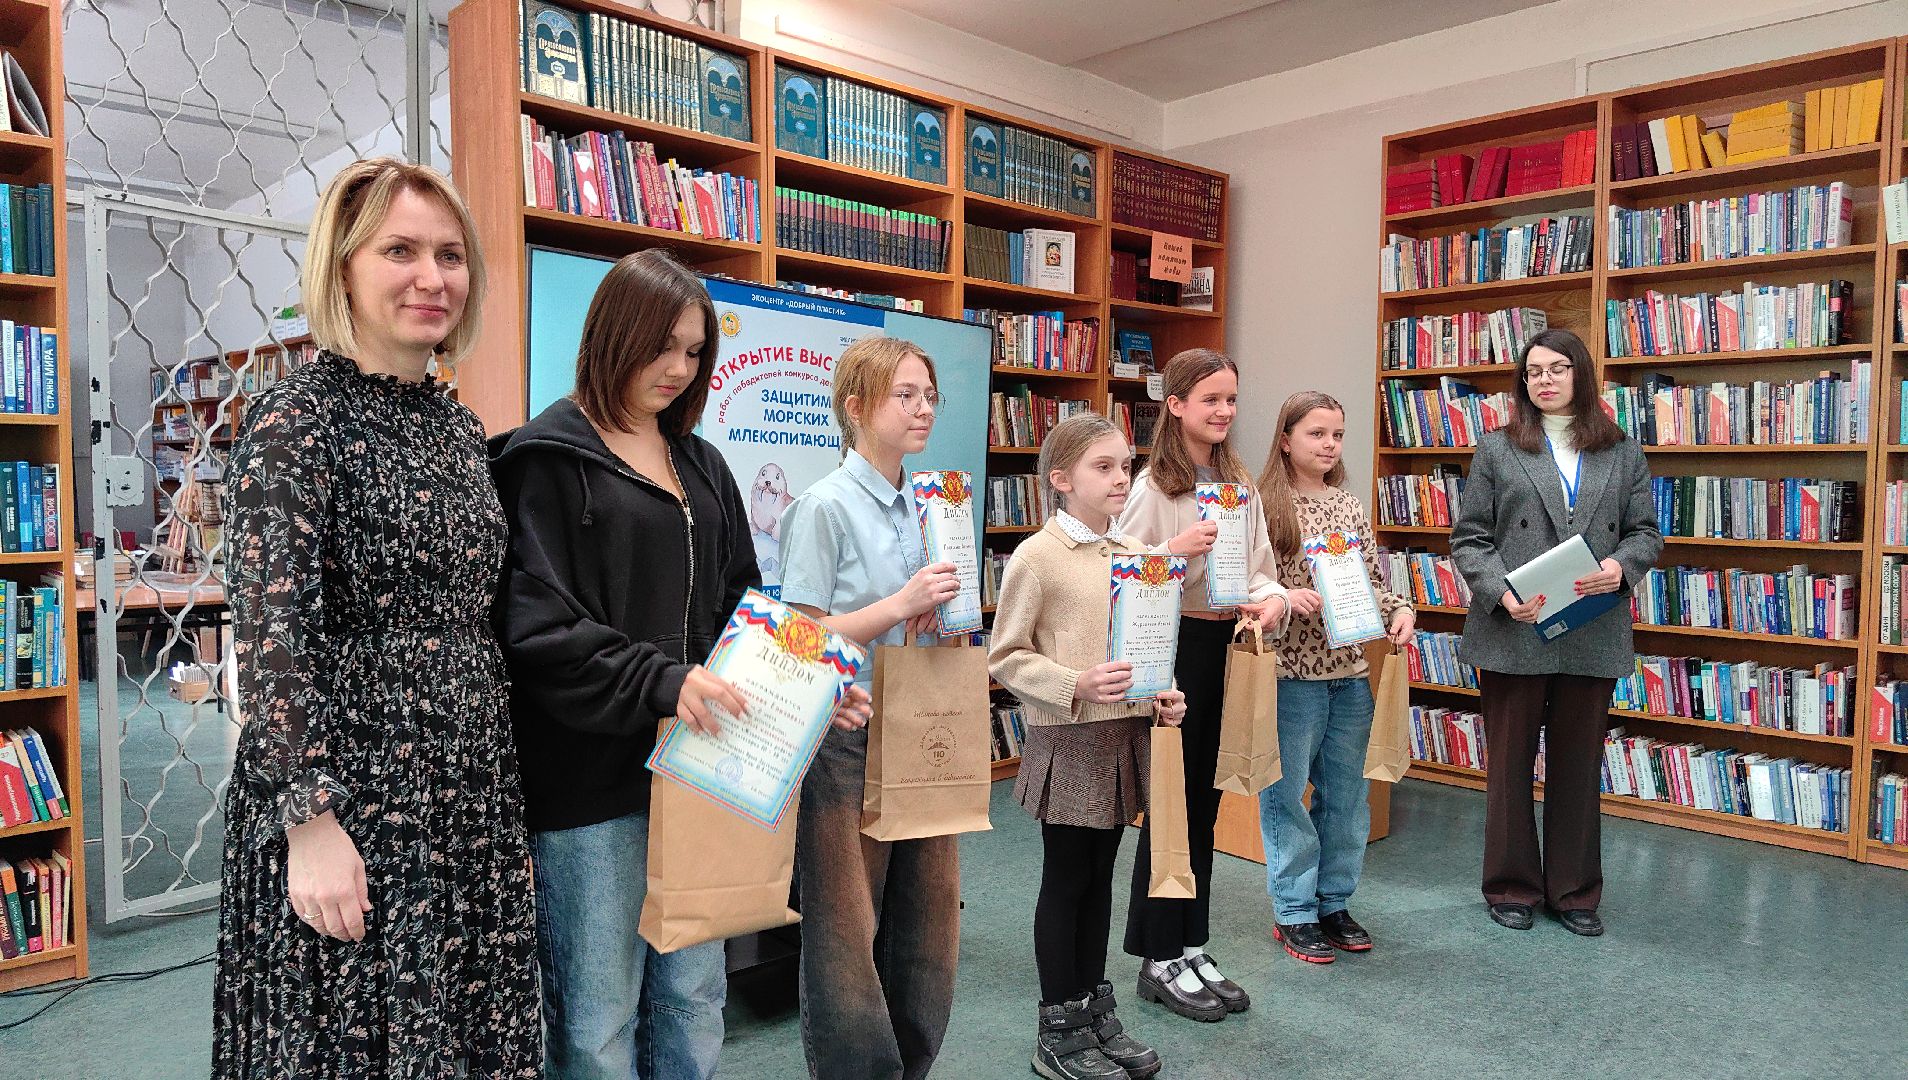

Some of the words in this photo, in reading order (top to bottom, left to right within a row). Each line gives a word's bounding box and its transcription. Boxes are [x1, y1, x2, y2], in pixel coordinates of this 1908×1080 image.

[751, 294, 785, 306] ЭКОЦЕНТР
[785, 300, 816, 311] «ДОБРЫЙ
[816, 305, 847, 316] ПЛАСТИК»
[44, 348, 55, 376] МИРА
[710, 347, 794, 391] ОТКРЫТИЕ
[800, 348, 834, 371] ВЫС
[46, 378, 55, 409] СТРАНЫ
[719, 395, 733, 424] работ
[732, 370, 781, 395] победителей
[784, 370, 818, 382] конкурса
[819, 379, 833, 388] дет
[761, 389, 832, 408] ЗАЩИТИМ
[763, 408, 829, 427] МОРСКИХ
[728, 428, 840, 451] МЛЕКОПИТАЮЩ
[47, 498, 56, 538] ЗООЛОГИЯ
[933, 750, 945, 758] 110
